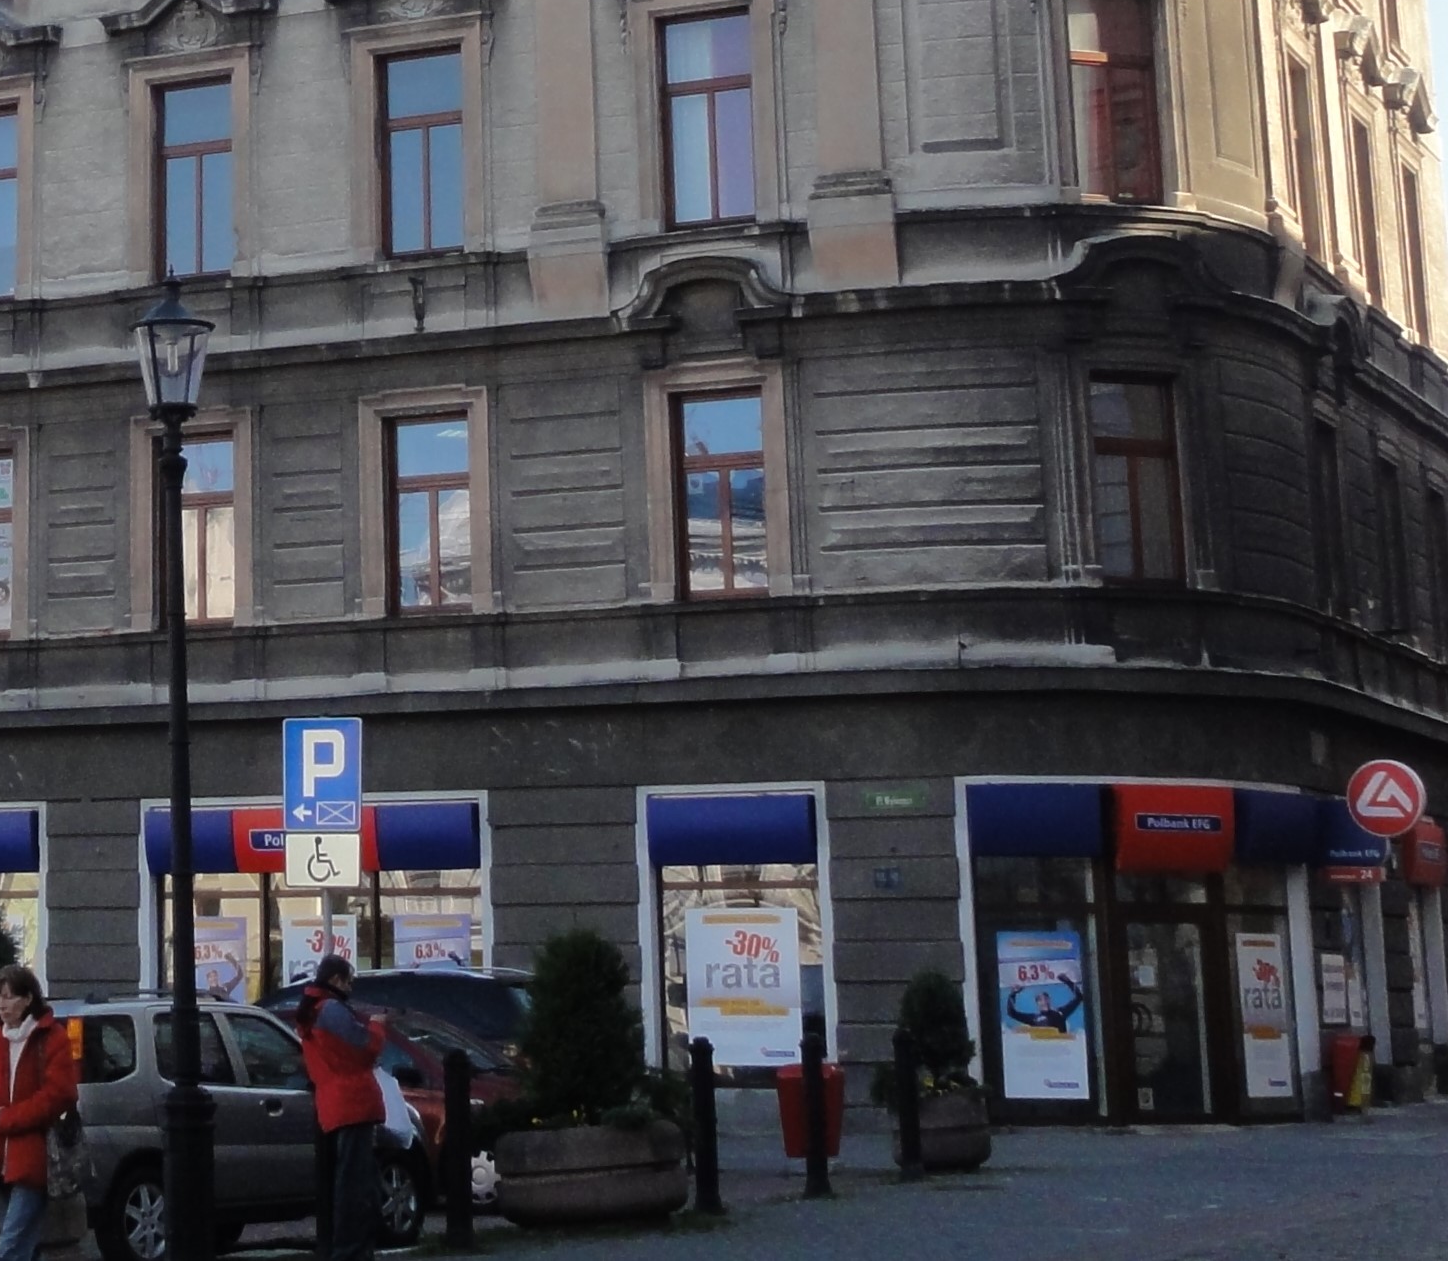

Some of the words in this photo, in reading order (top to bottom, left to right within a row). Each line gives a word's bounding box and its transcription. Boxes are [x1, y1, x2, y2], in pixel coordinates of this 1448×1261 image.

[303, 729, 345, 797] P
[1147, 817, 1190, 829] Polbank
[1192, 818, 1211, 830] EFG
[264, 833, 284, 847] Pol
[1360, 869, 1374, 880] 24
[724, 929, 780, 964] -30%
[705, 957, 781, 989] rata
[1243, 983, 1283, 1010] rata
